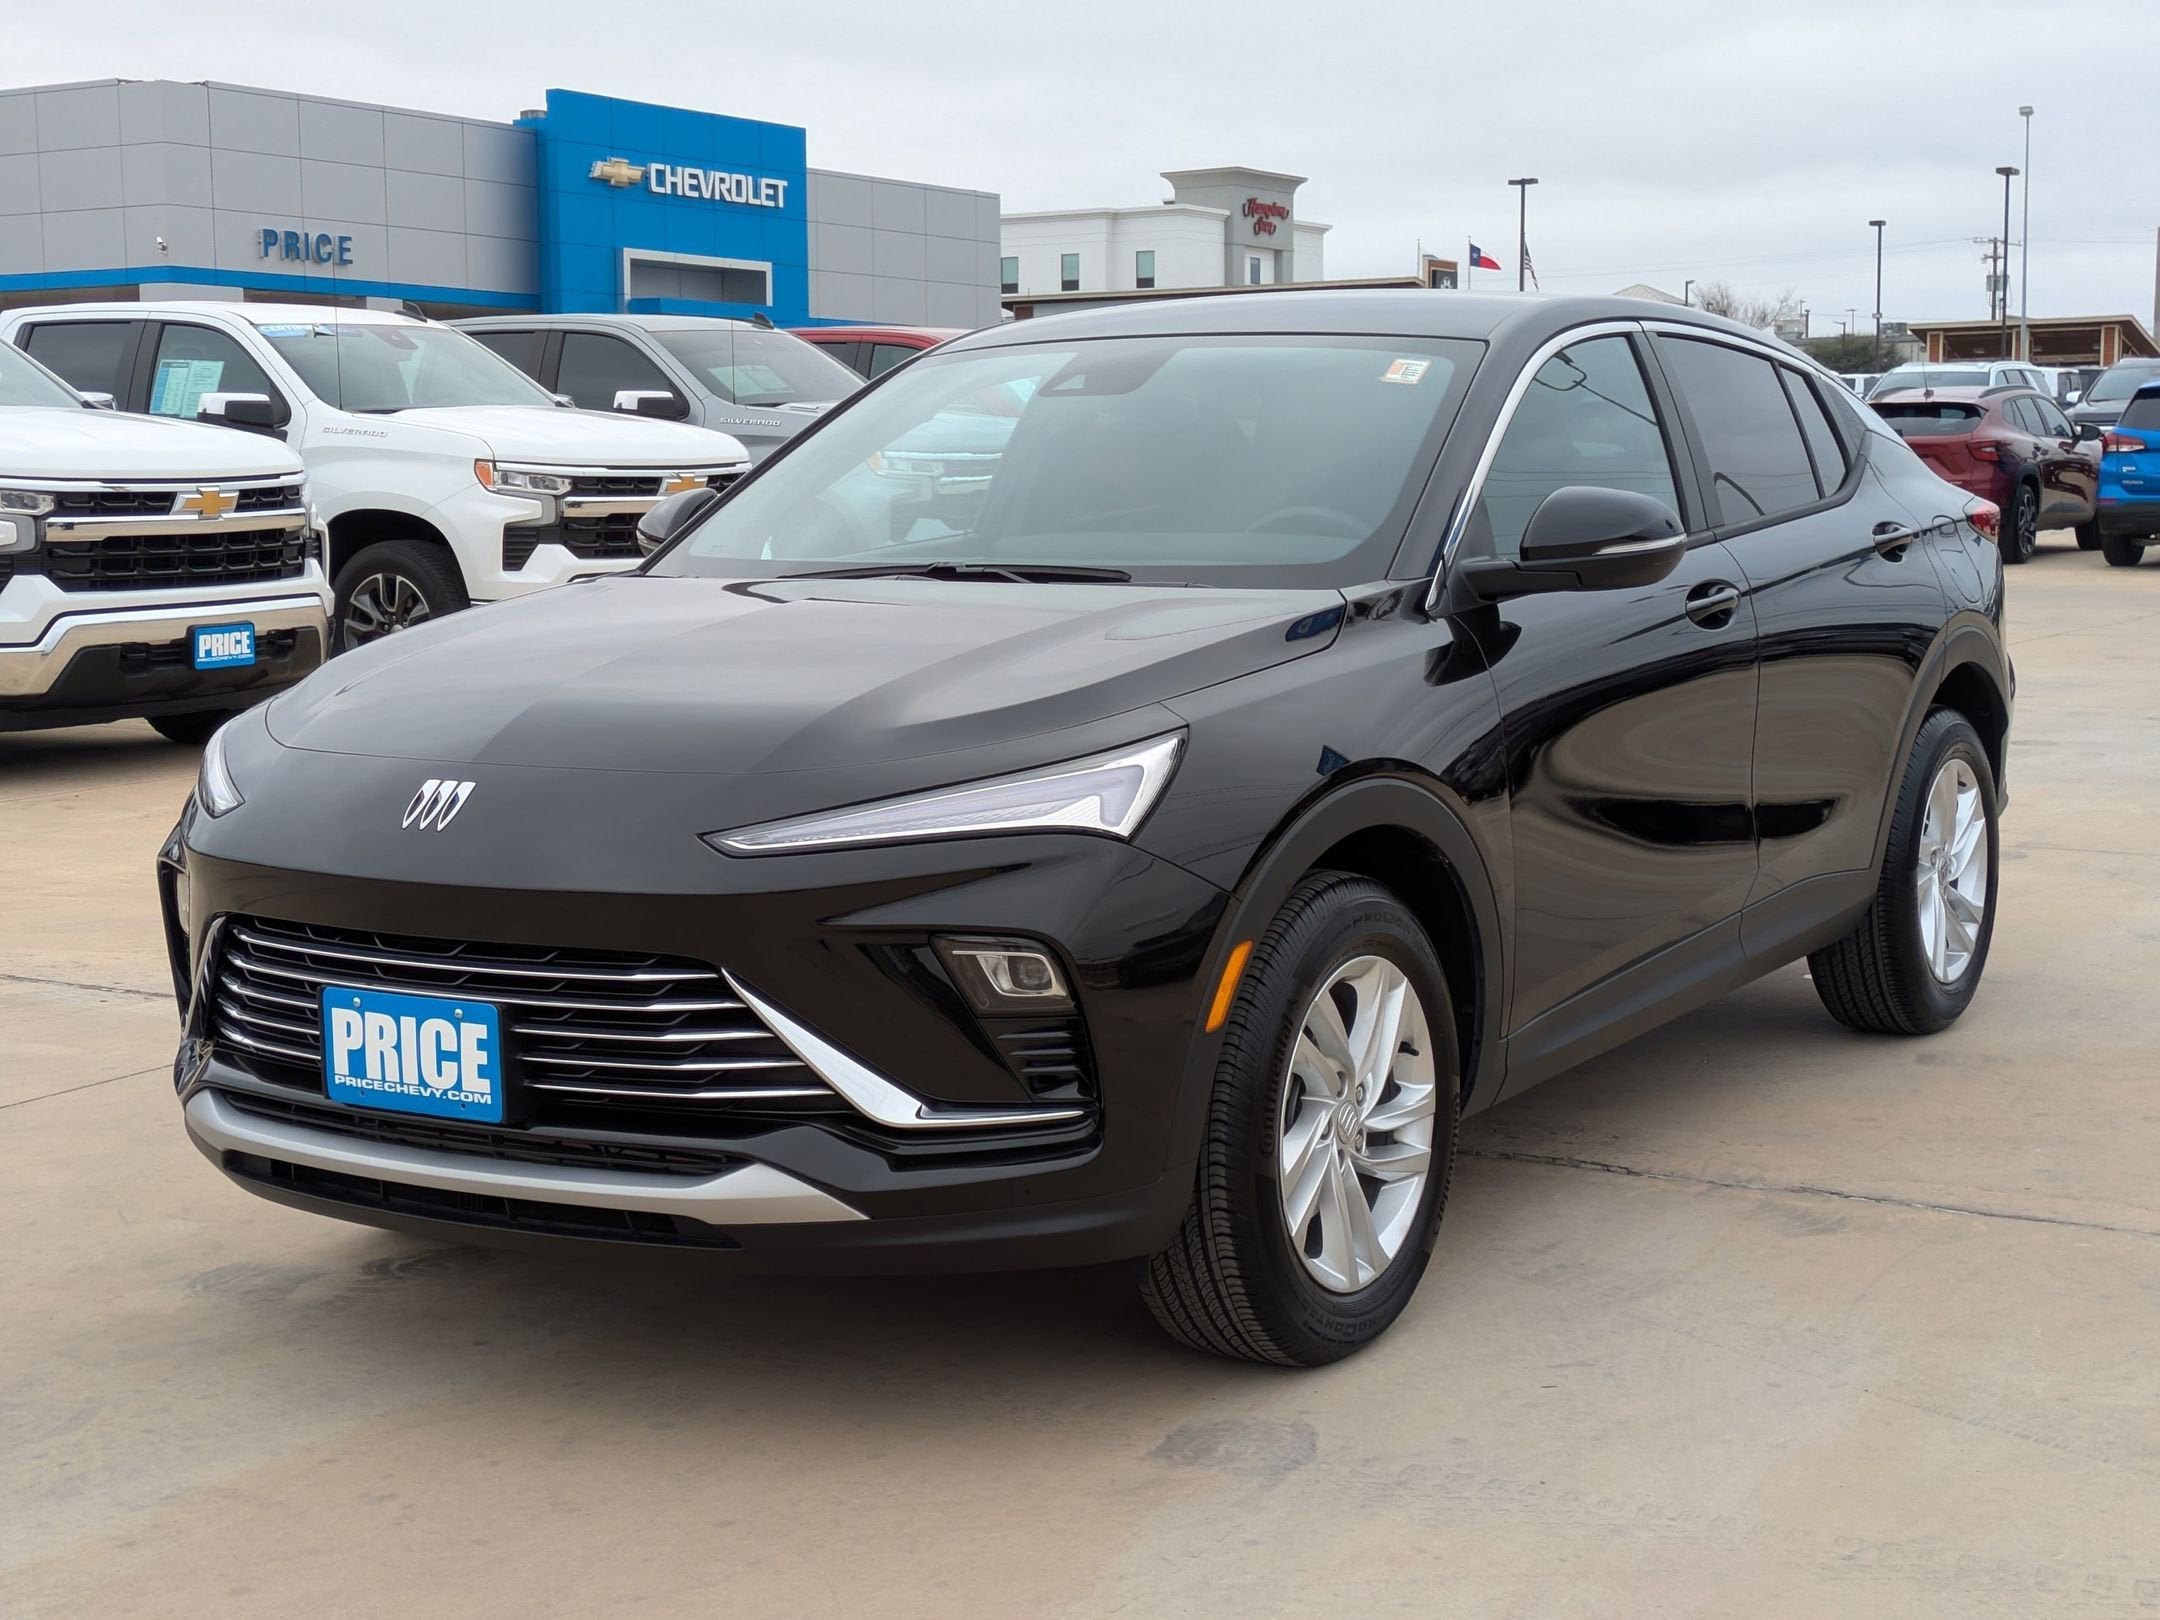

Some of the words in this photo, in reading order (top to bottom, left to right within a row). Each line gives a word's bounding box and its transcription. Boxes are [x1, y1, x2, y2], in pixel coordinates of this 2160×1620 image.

[648, 163, 788, 208] CHEVROLET
[1242, 197, 1289, 220] Hampton
[1253, 216, 1277, 236] Inn
[259, 228, 354, 266] PRICE
[322, 426, 389, 438] SILVERADO
[720, 417, 782, 427] SILVERADO
[198, 631, 251, 658] PRICE
[331, 1007, 491, 1094] PRICE
[334, 1074, 492, 1105] PRICECHEVY.COM
